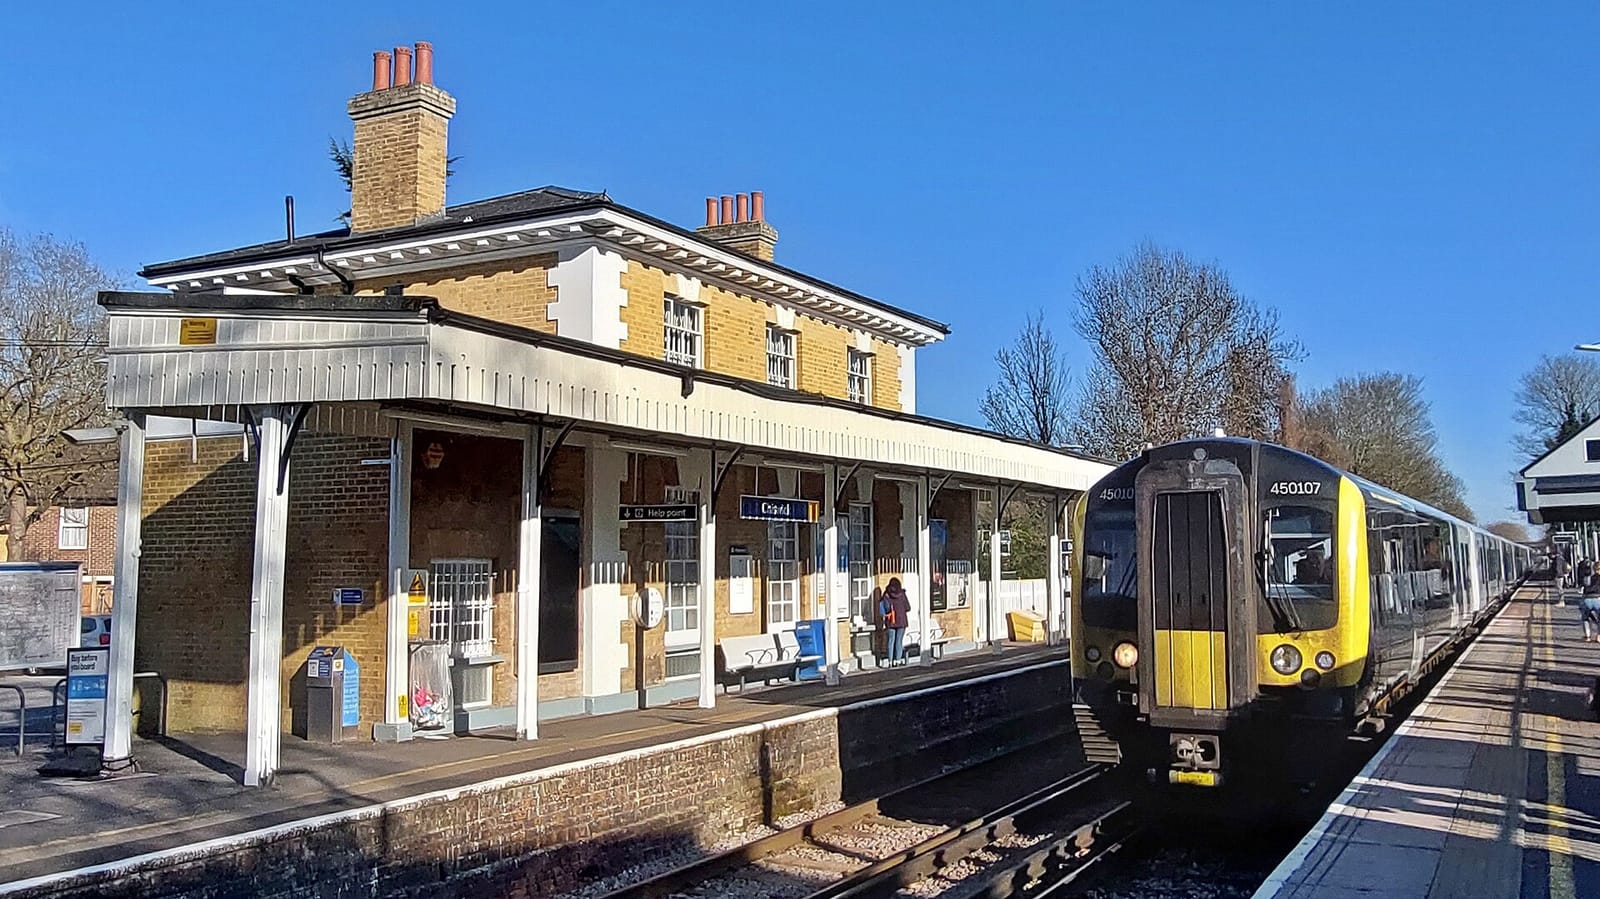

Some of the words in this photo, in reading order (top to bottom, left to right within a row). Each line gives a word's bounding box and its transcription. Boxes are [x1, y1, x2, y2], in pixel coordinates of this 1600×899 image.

[1099, 487, 1135, 500] 45010
[1270, 481, 1322, 495] 450107
[648, 508, 665, 518] Help
[666, 508, 687, 518] point
